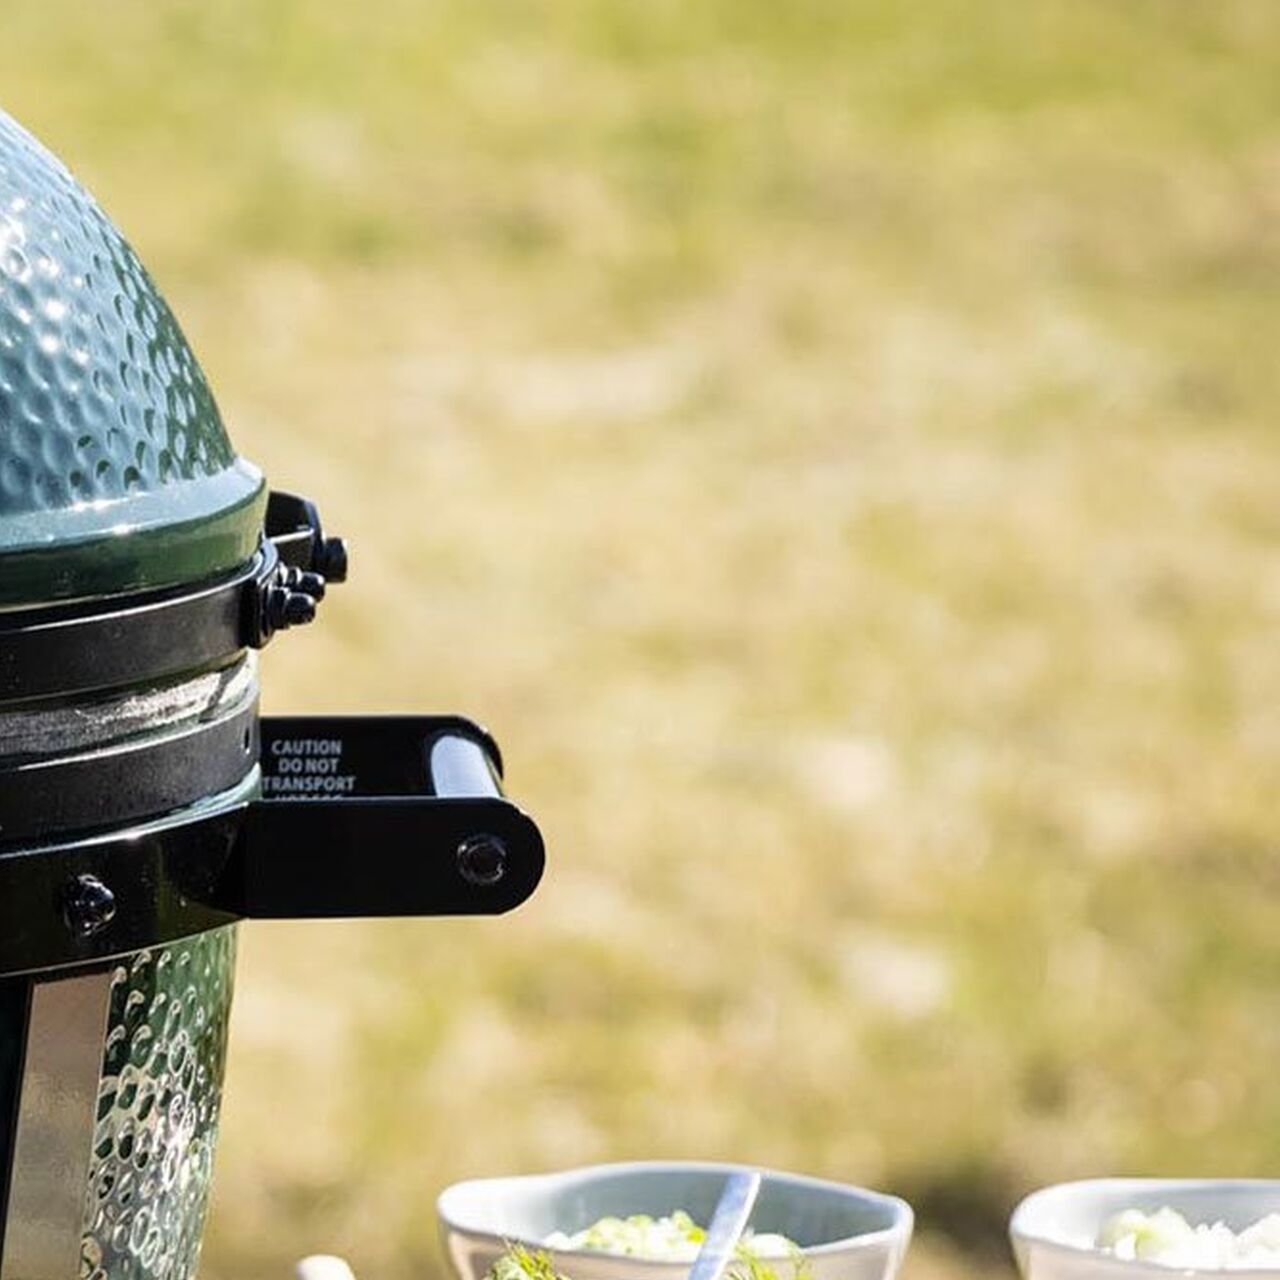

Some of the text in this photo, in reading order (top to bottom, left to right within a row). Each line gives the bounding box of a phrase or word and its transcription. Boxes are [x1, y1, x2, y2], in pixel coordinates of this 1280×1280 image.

[271, 739, 342, 755] CAUTION
[278, 758, 339, 773] DO NOT
[263, 775, 356, 791] TRANSPORT
